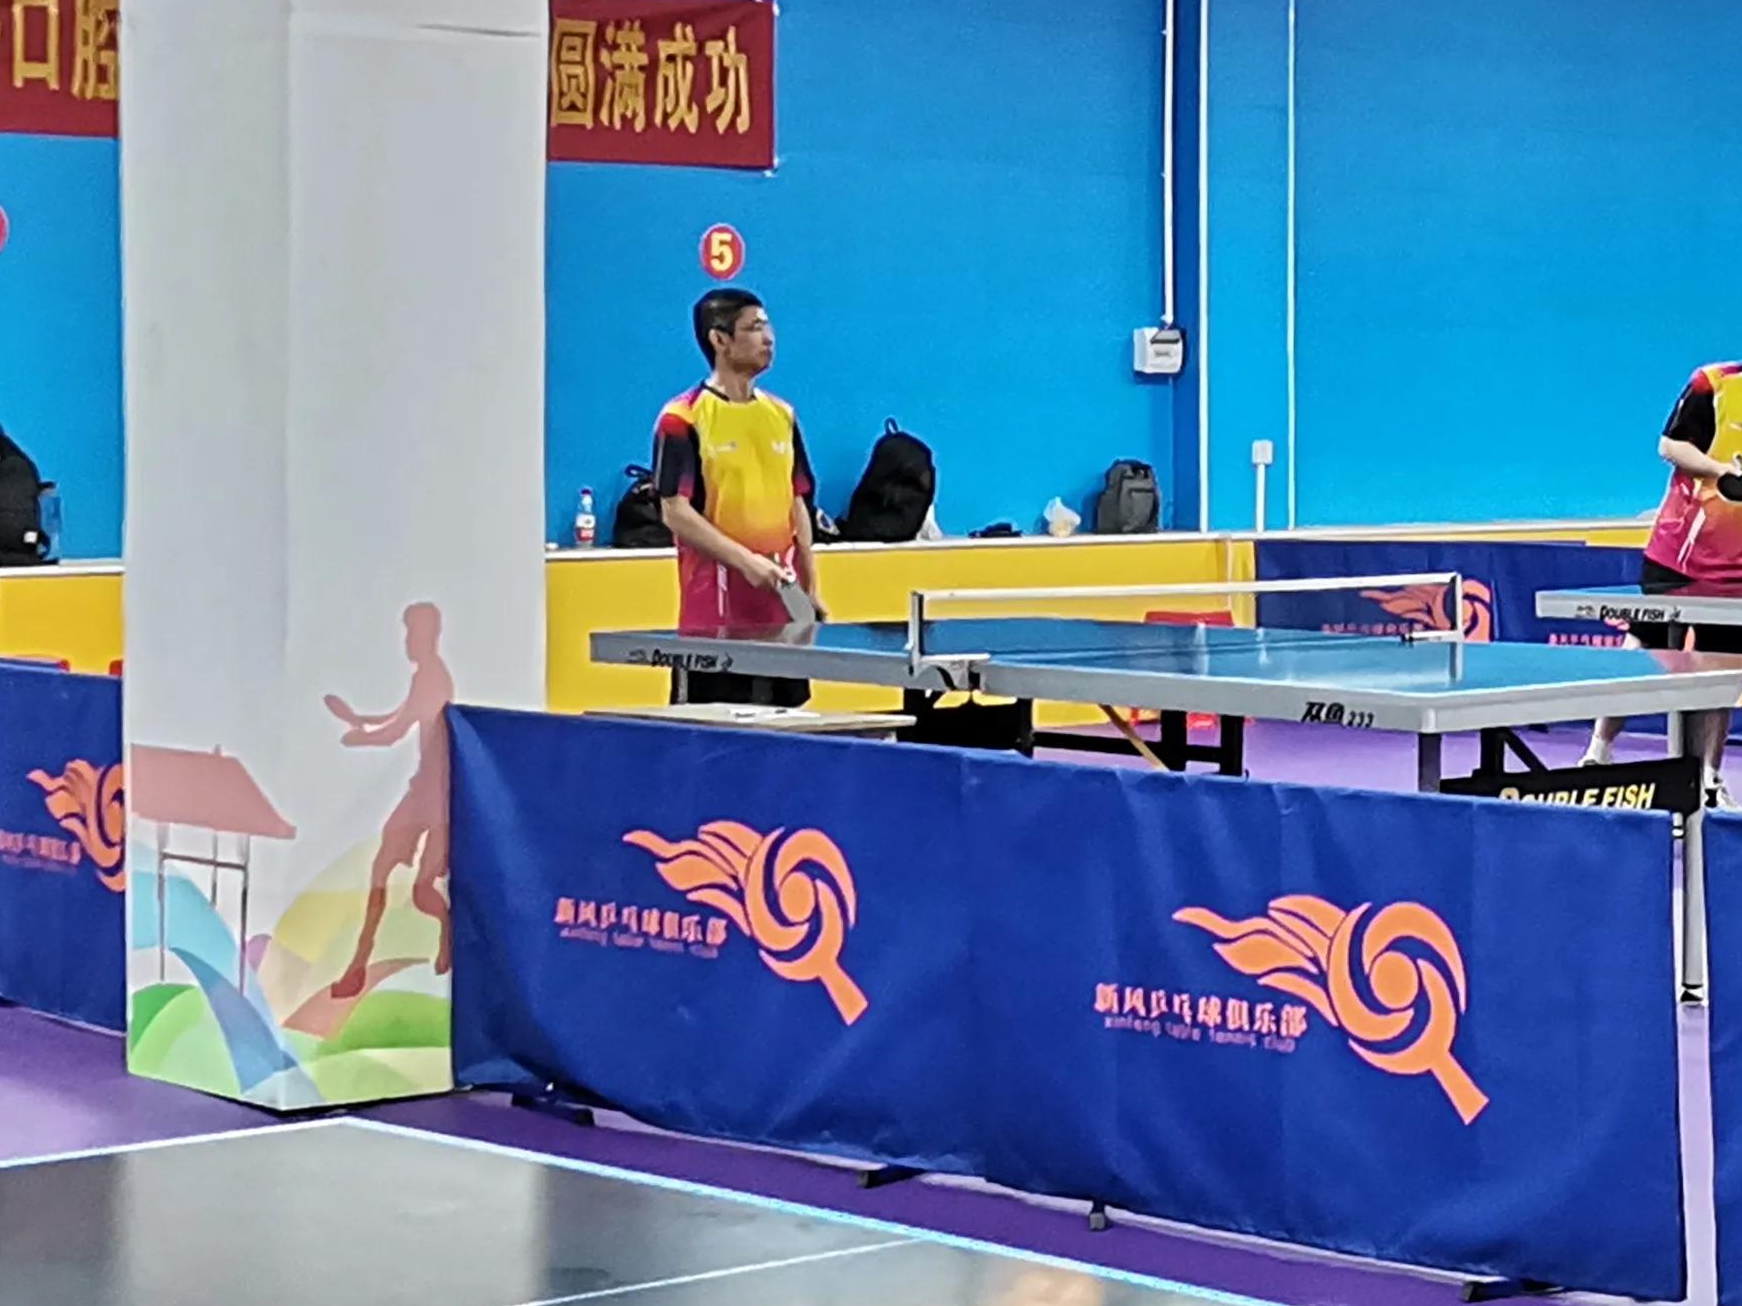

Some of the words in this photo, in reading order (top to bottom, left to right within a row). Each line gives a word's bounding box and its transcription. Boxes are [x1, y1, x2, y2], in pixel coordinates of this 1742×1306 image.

[550, 16, 751, 135] 圆满成功
[709, 232, 734, 272] 5
[1601, 782, 1656, 809] FISH
